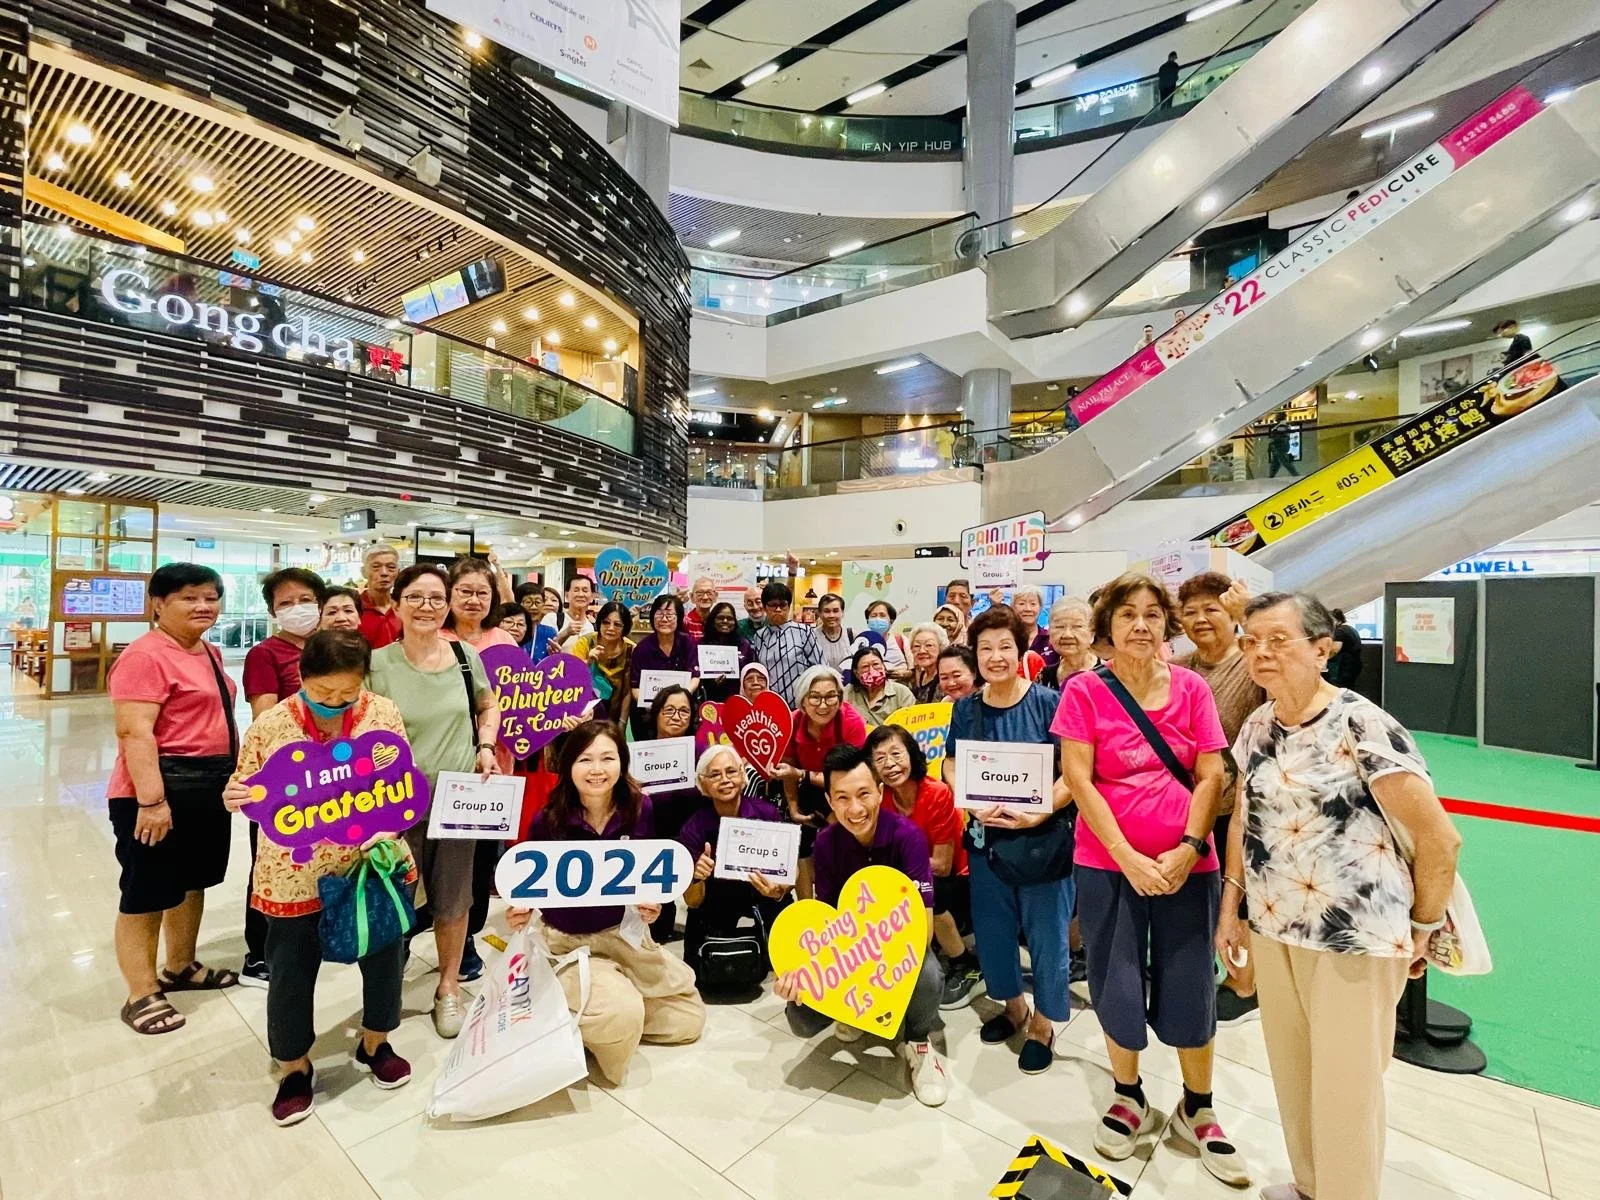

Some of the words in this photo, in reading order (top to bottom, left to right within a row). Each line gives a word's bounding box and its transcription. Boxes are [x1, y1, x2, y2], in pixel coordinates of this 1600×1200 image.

[530, 11, 563, 33] COURTS
[559, 49, 587, 67] Singtel
[899, 141, 918, 152] YIP
[925, 140, 952, 151] HUB
[1265, 218, 1347, 279] CLASSIC
[1347, 153, 1440, 221] PEDICURE
[102, 269, 265, 353] Gong
[272, 314, 356, 365] cha
[1078, 393, 1099, 412] NAIL
[1098, 372, 1130, 401] PALACE
[1336, 463, 1378, 491] #05-11
[1283, 490, 1324, 517] 店小二
[967, 525, 1008, 548] PAINT
[1013, 521, 1026, 537] IT
[611, 560, 640, 576] Being
[642, 561, 653, 572] A
[756, 563, 805, 577] hickn
[599, 570, 662, 589] Volunteer
[612, 590, 624, 601] Is
[626, 590, 652, 601] Cool
[495, 665, 544, 690] Being
[548, 660, 565, 680] A
[502, 716, 523, 737] Is
[734, 709, 783, 740] Healthier
[911, 714, 926, 724] am
[912, 725, 949, 744] ppy
[750, 738, 771, 756] SG
[305, 769, 313, 789] I
[319, 764, 352, 786] am
[644, 763, 671, 771] Group
[673, 760, 679, 768] 2
[982, 771, 1019, 784] Group
[1022, 773, 1029, 783] 7
[274, 772, 413, 835] Grateful
[453, 800, 487, 813] Group
[490, 802, 504, 812] 10
[739, 844, 769, 858] Group
[772, 848, 779, 857] 6
[510, 848, 679, 898] 2024
[799, 911, 858, 957] Being
[857, 882, 876, 914] A
[795, 899, 912, 1002] Volunteer
[844, 986, 873, 1019] Is
[869, 944, 918, 991] Cool
